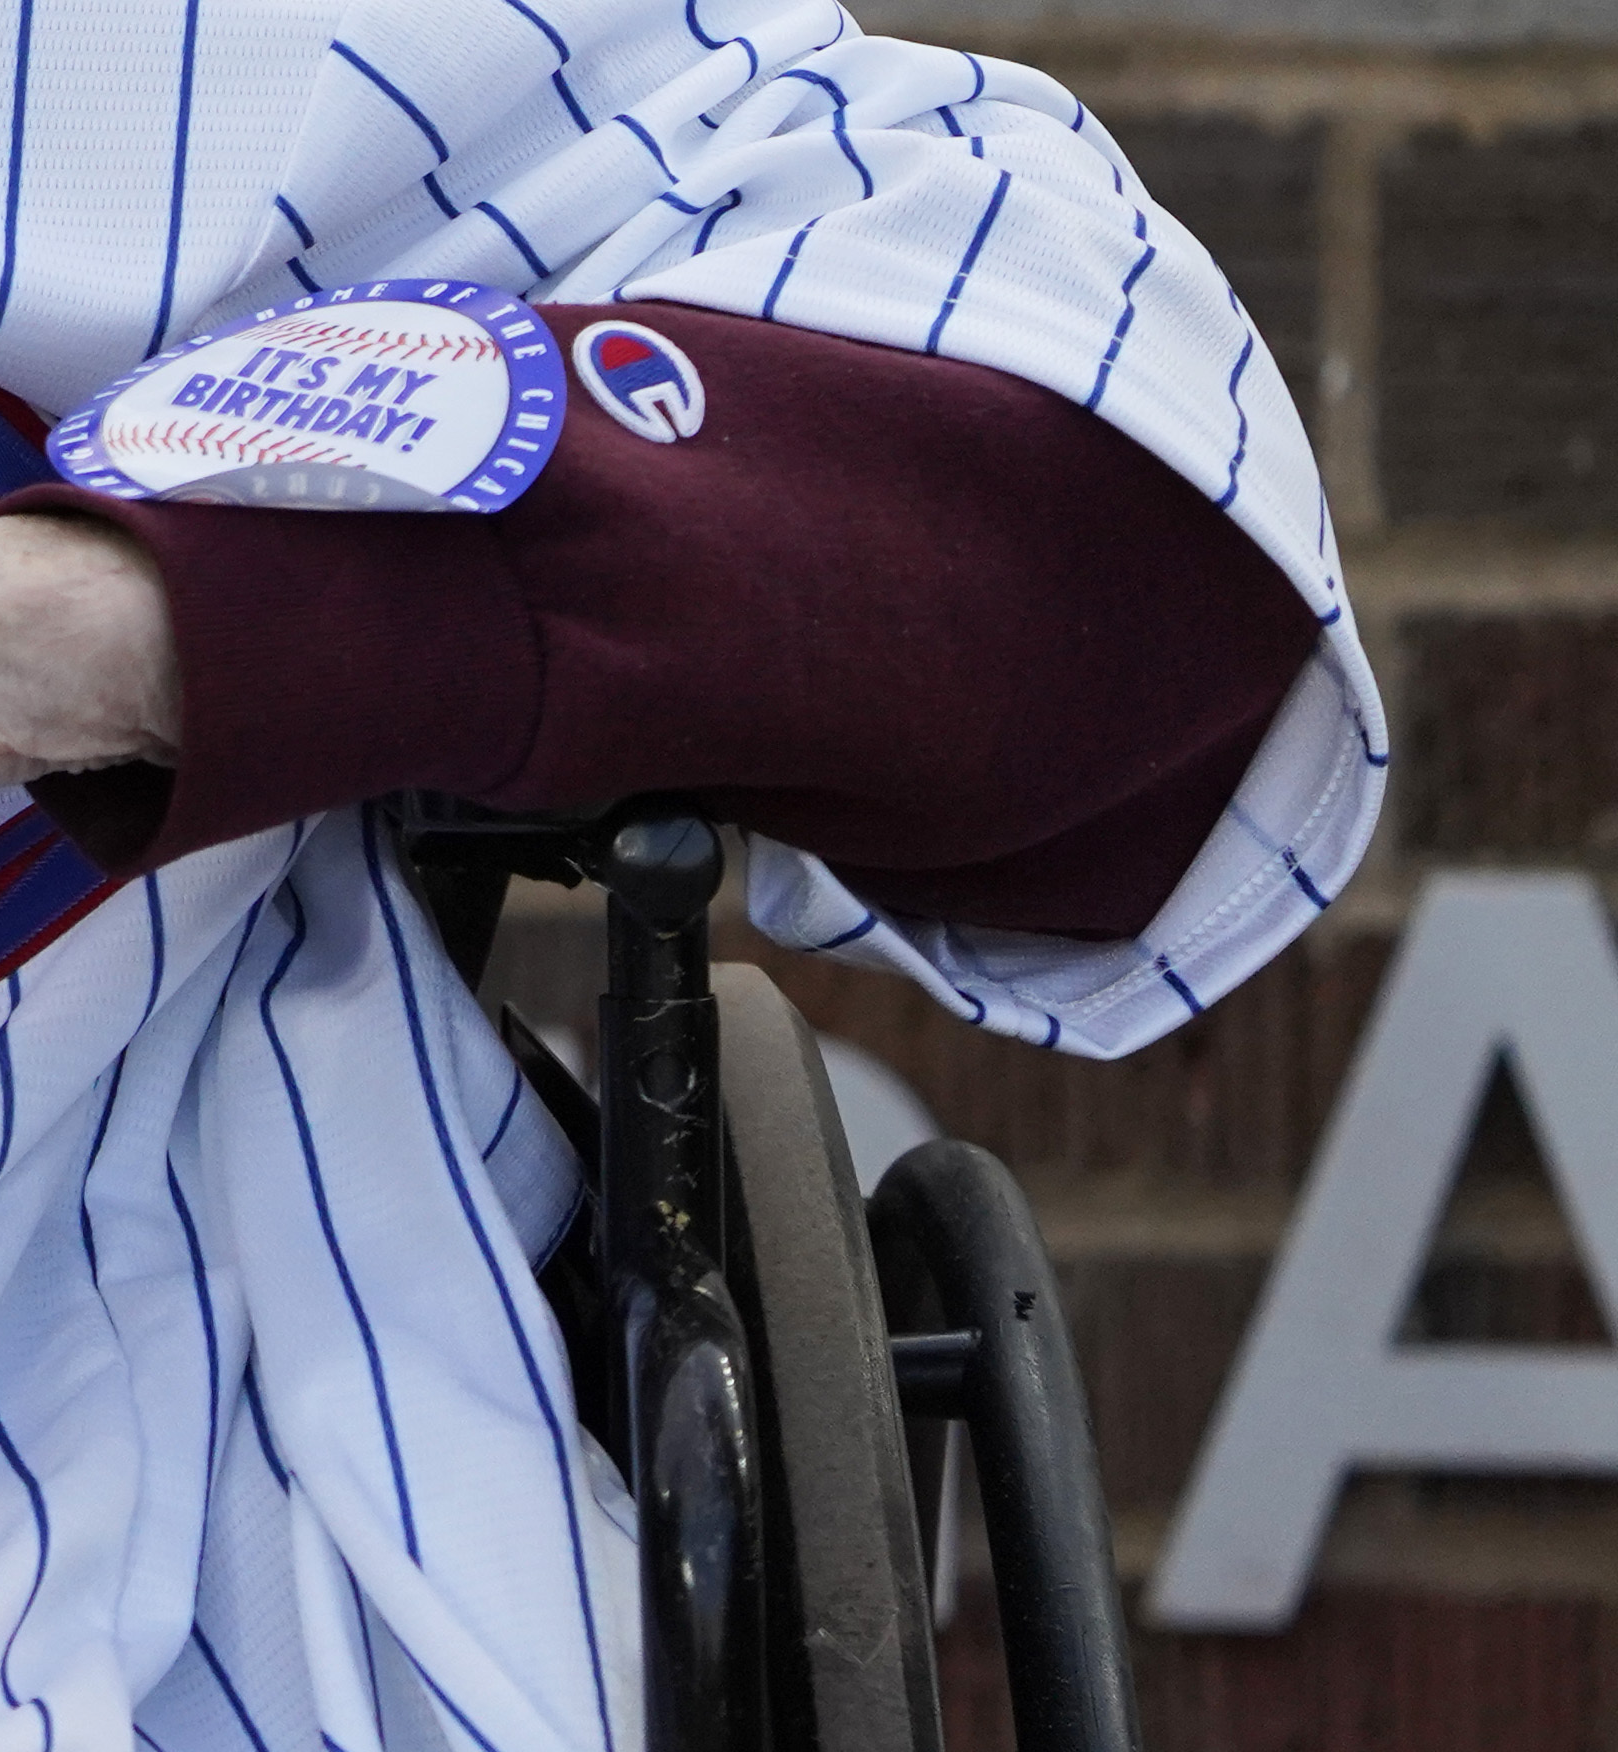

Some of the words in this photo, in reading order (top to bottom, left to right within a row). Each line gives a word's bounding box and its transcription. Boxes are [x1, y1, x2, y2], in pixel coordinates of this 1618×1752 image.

[256, 282, 389, 321] HOME
[422, 282, 478, 304] OF
[486, 303, 548, 360] THE
[170, 372, 438, 453] BIRTHDAY!
[236, 347, 341, 391] IT'S
[343, 363, 439, 406] MY
